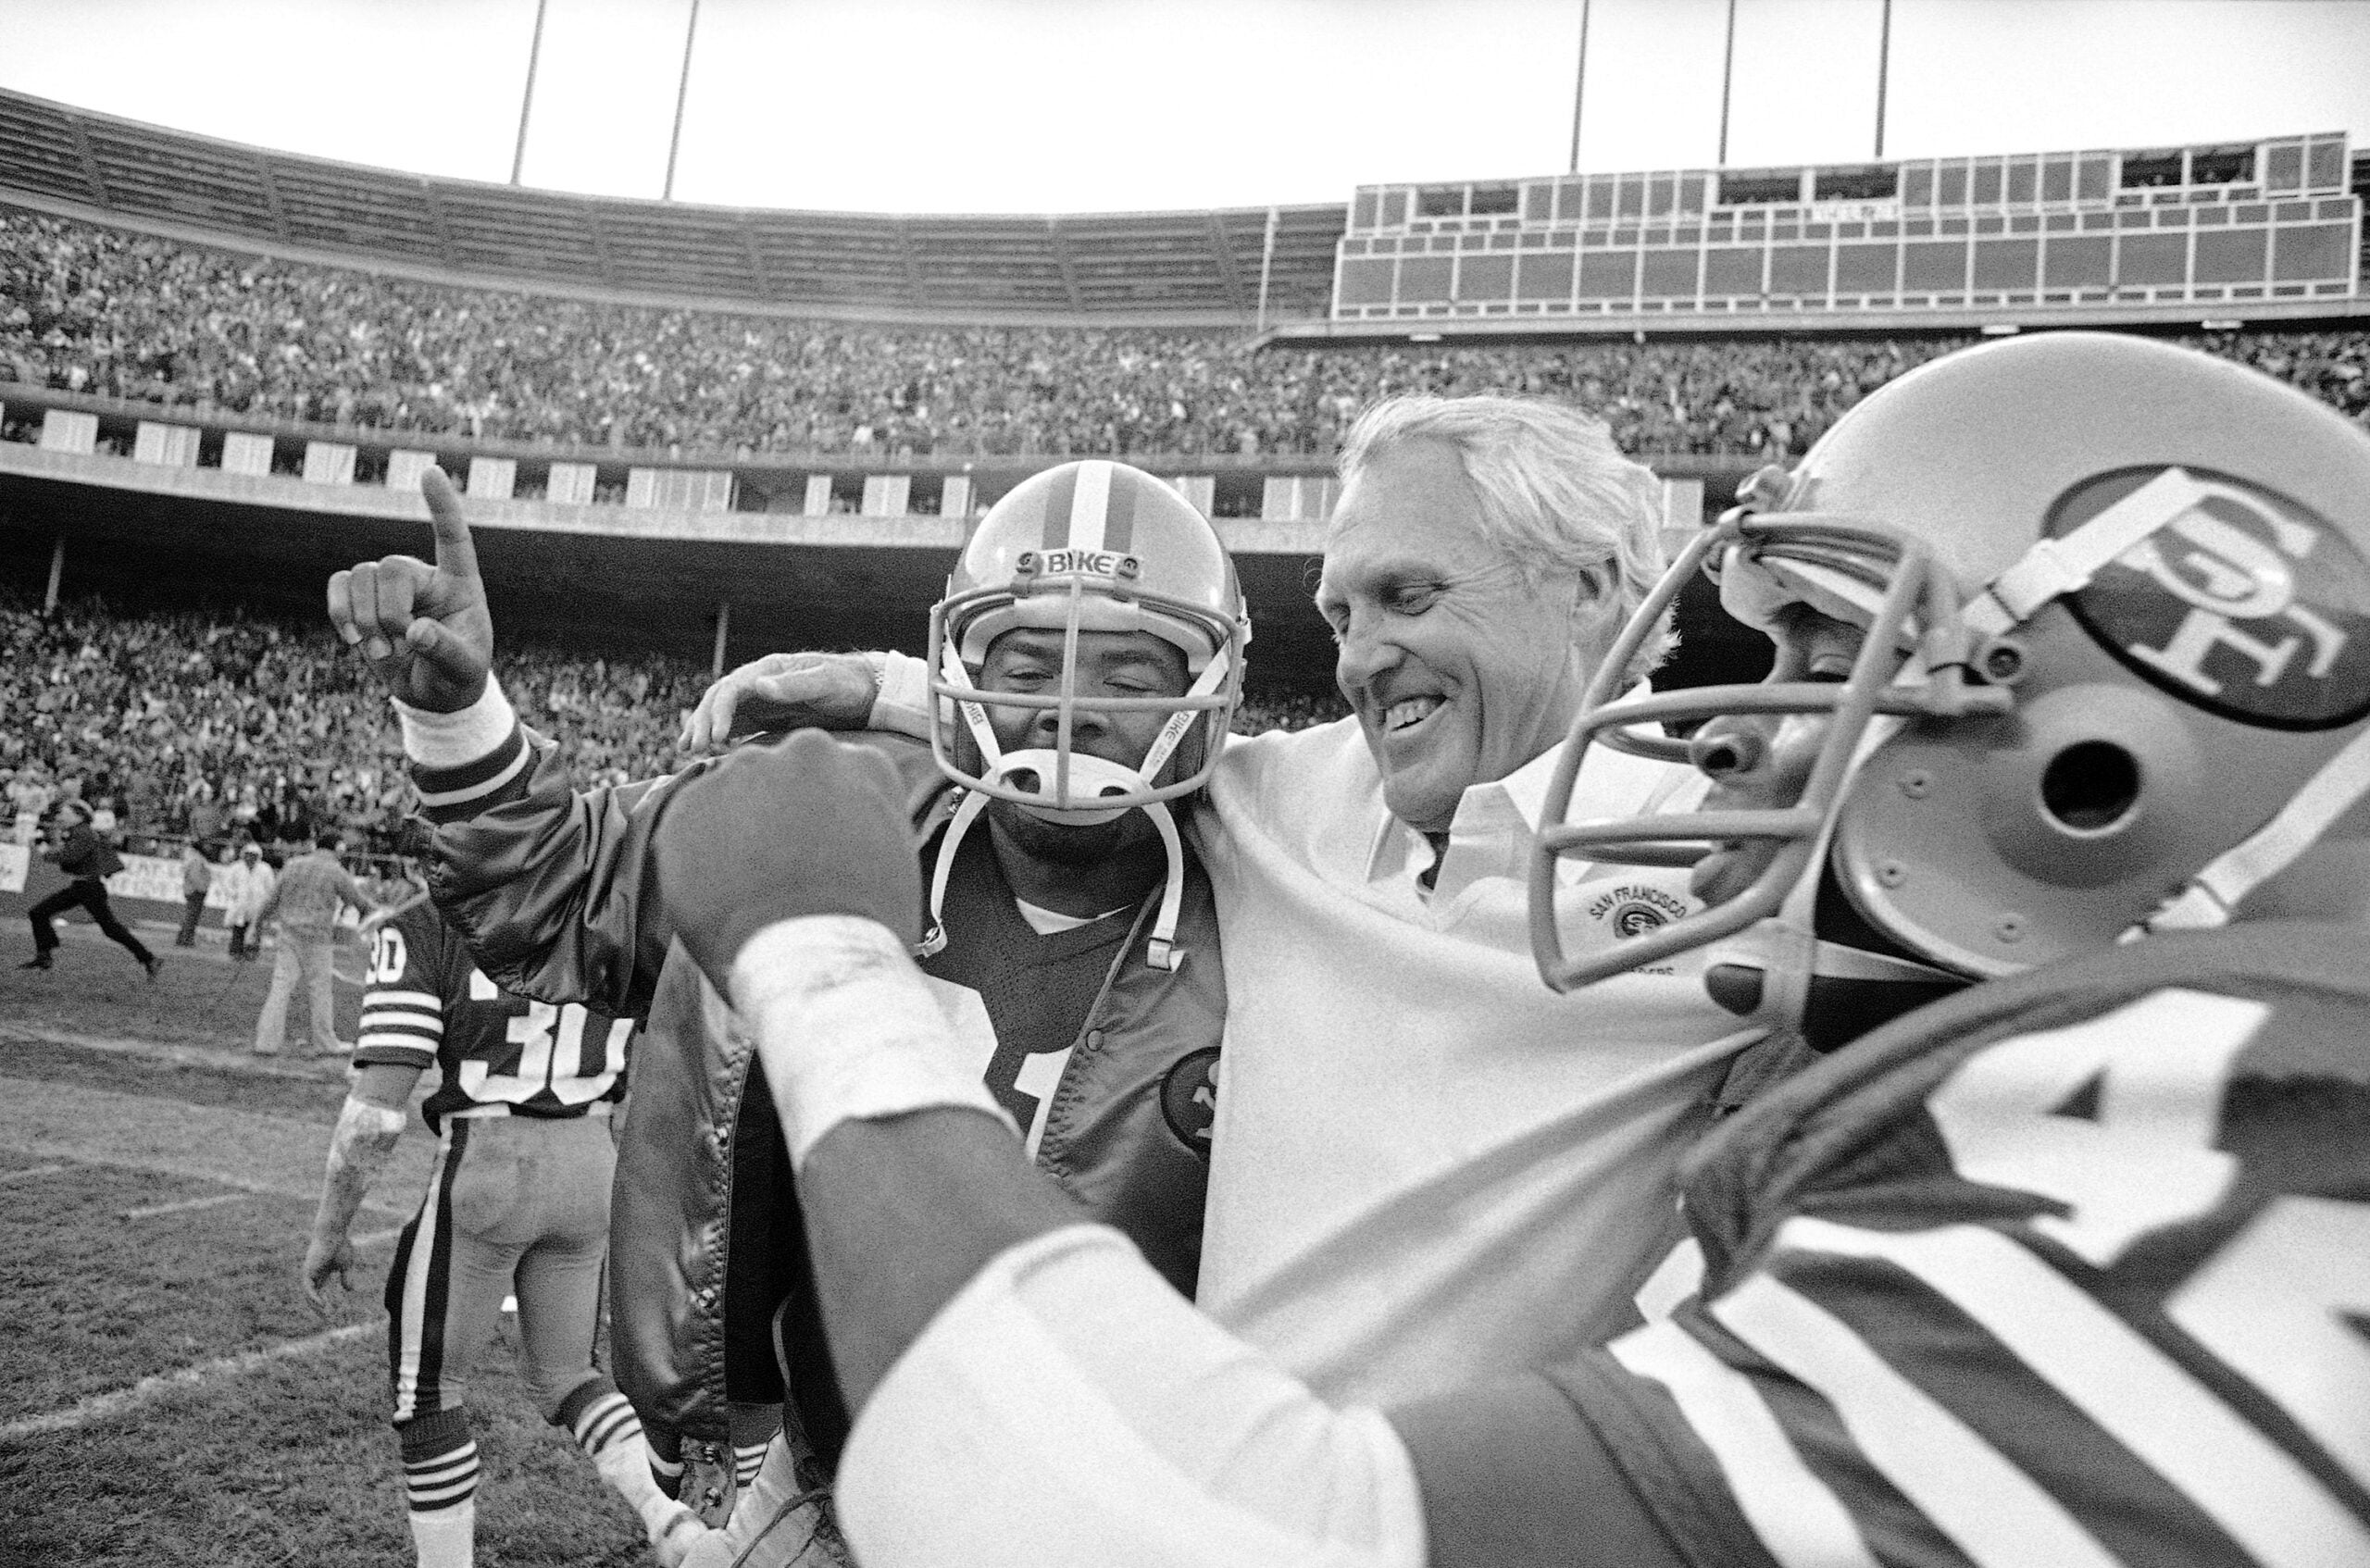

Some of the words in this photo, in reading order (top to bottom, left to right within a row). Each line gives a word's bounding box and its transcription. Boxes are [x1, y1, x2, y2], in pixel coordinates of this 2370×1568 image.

[1048, 551, 1115, 574] BIKE
[964, 701, 984, 726] BIK
[1165, 711, 1191, 741] BIKE
[1589, 894, 1615, 921] SAN
[1614, 886, 1687, 919] FRANCISCO
